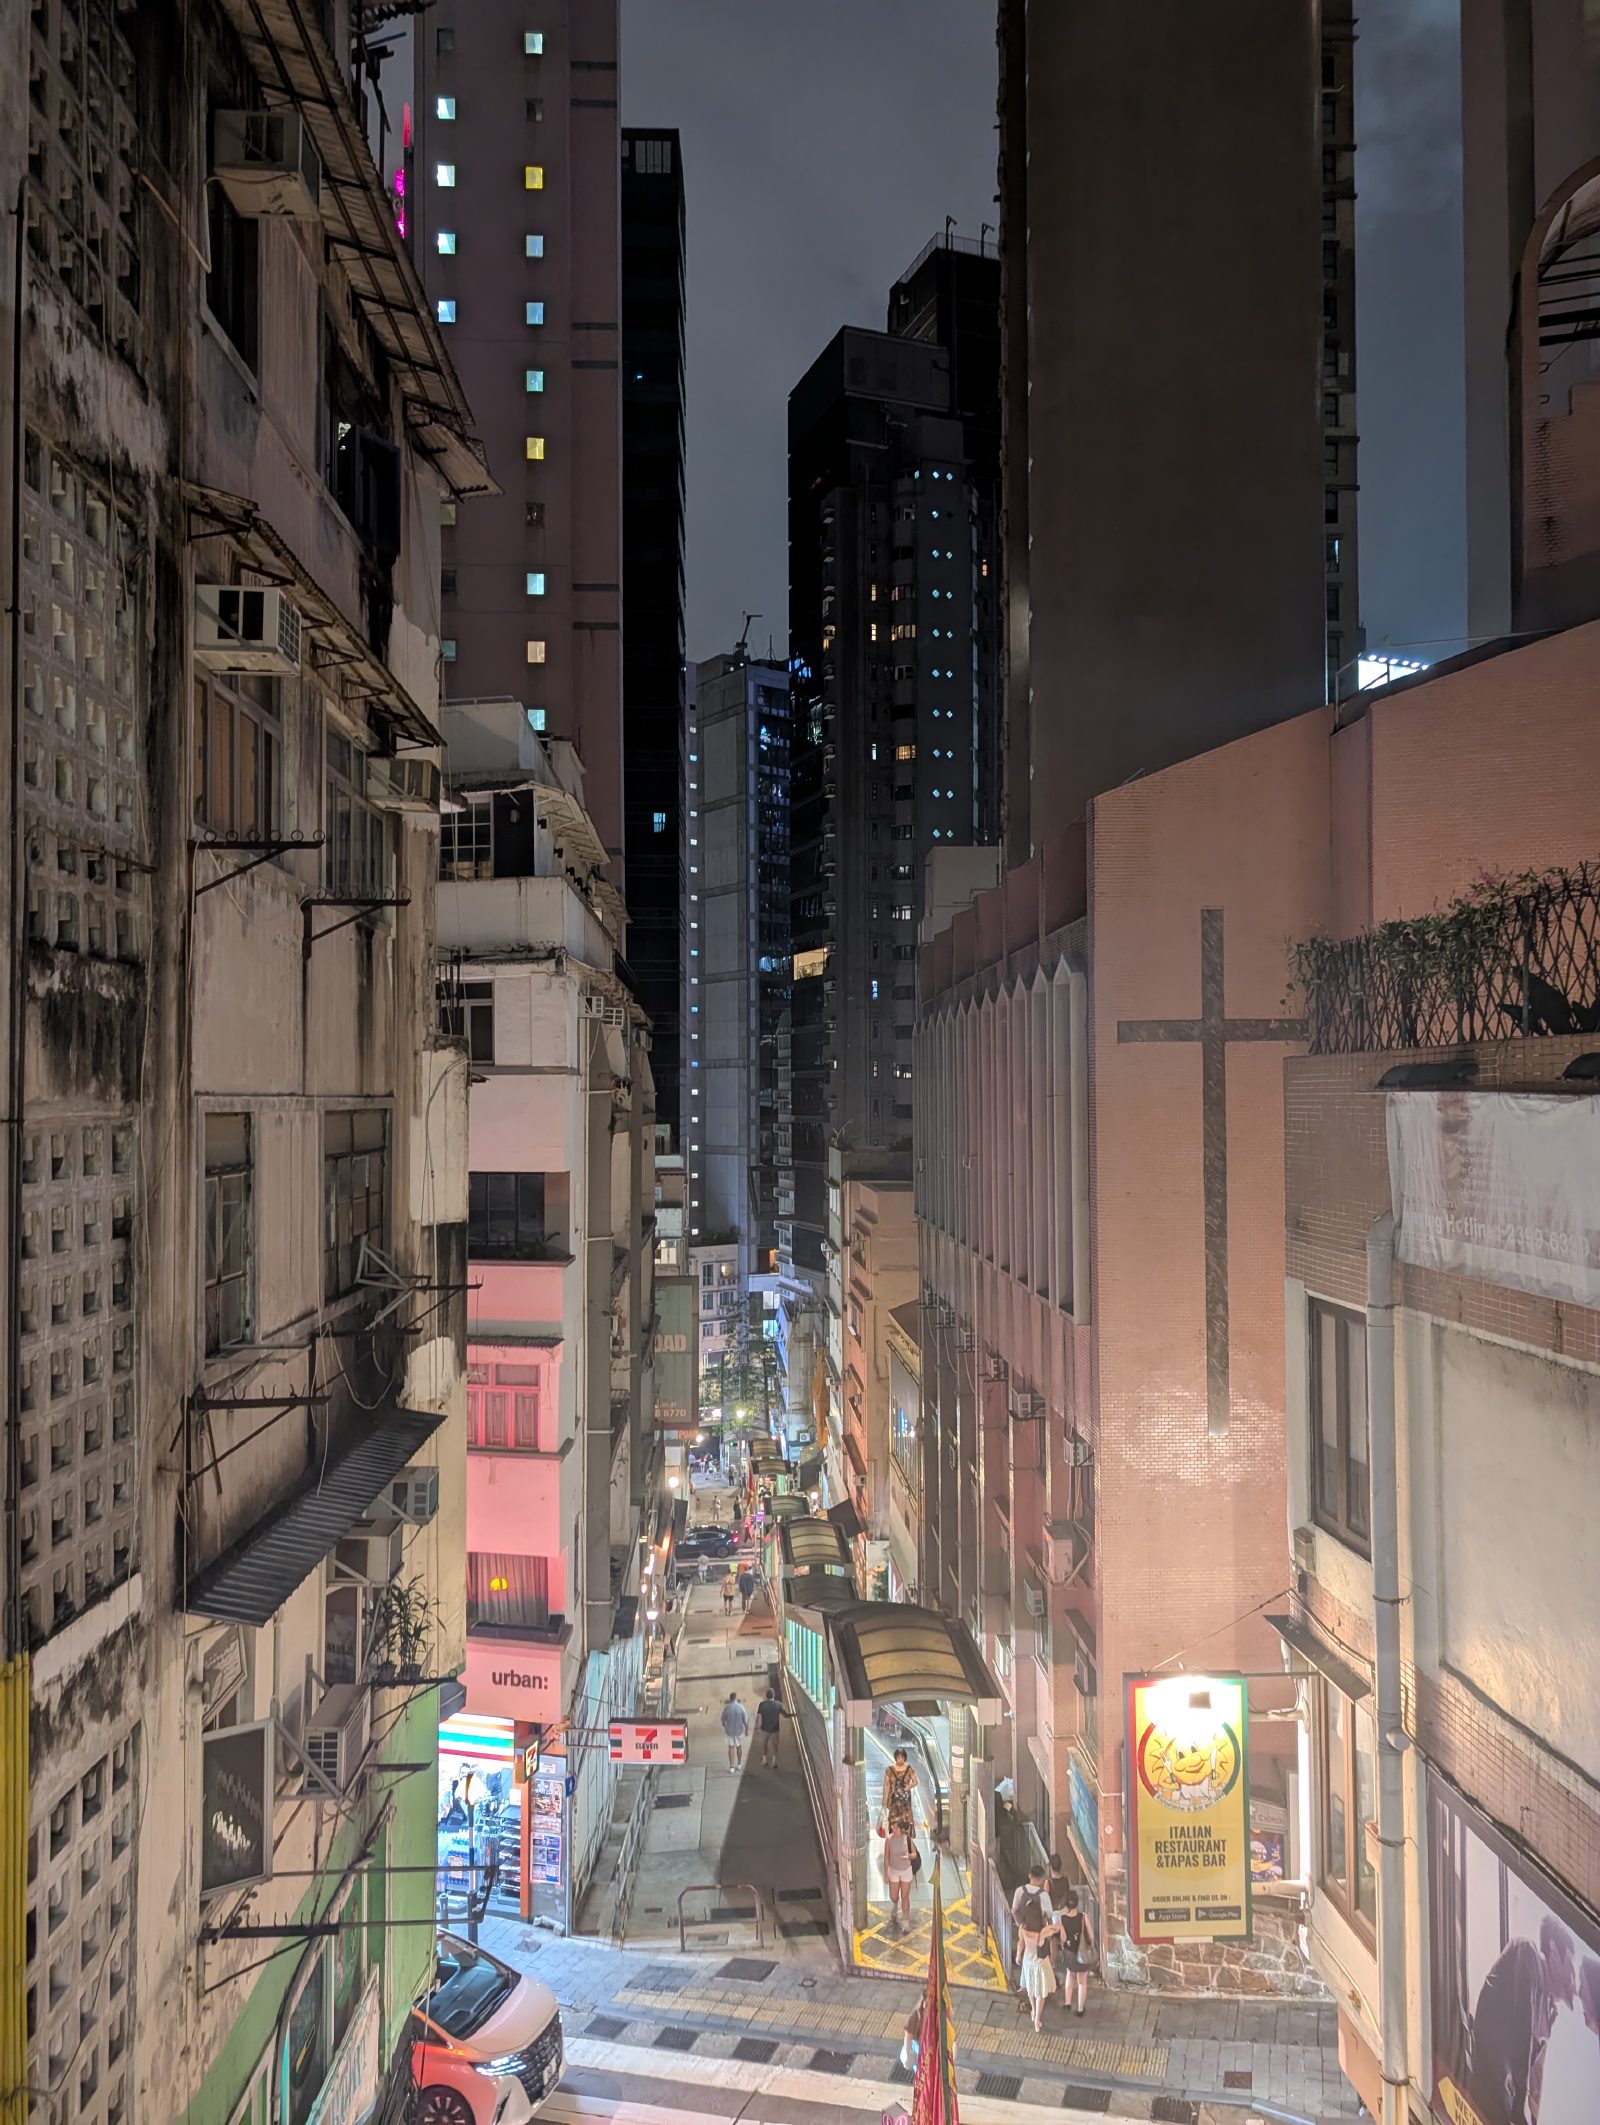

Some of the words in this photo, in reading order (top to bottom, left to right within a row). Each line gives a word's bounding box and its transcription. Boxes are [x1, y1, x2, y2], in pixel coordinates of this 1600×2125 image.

[491, 1669, 549, 1690] urban:
[635, 1727, 658, 1759] 7
[1169, 1825, 1212, 1840] ITALIAN
[1154, 1839, 1228, 1854] RESTAURANT
[1156, 1853, 1200, 1869] &TAPAS
[1202, 1853, 1227, 1868] BAR
[1172, 1894, 1191, 1902] ONLINE
[1198, 1894, 1211, 1902] FIND
[1211, 1894, 1219, 1902] US
[1220, 1893, 1228, 1901] ON
[1159, 1912, 1171, 1921] App
[1171, 1911, 1187, 1920] Store
[1208, 1911, 1227, 1919] Google
[1228, 1910, 1239, 1919] Play
